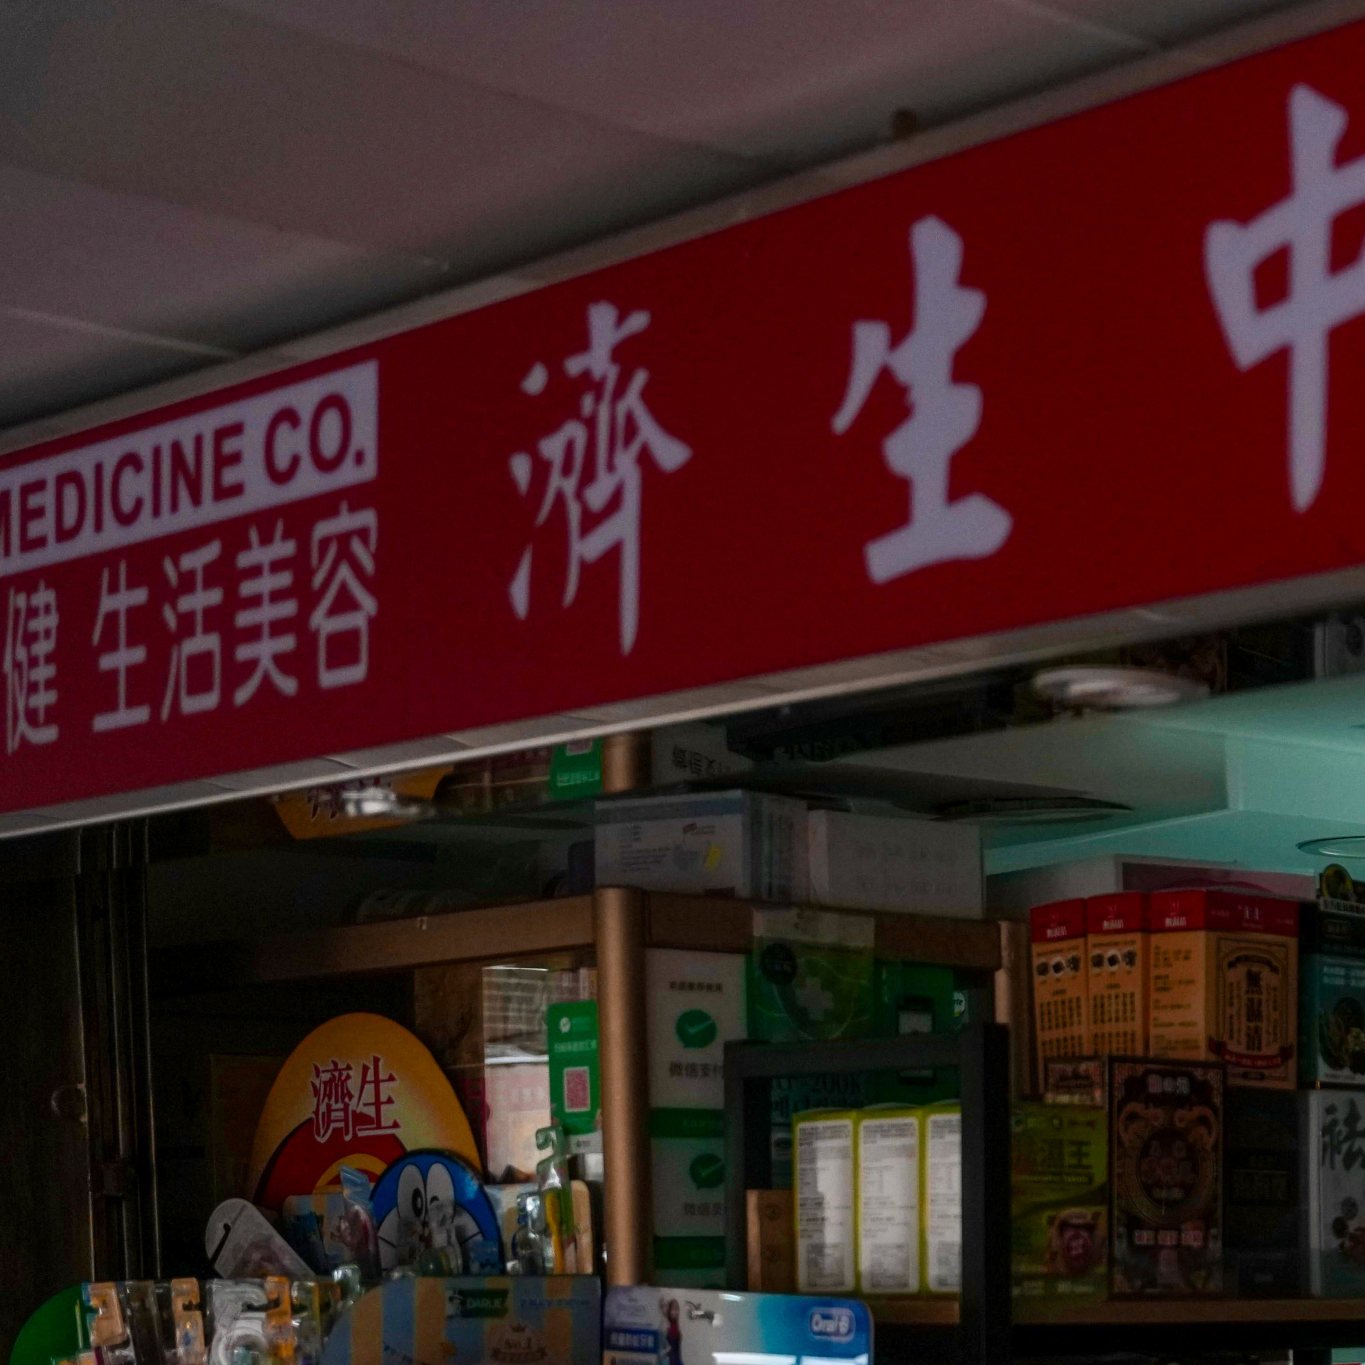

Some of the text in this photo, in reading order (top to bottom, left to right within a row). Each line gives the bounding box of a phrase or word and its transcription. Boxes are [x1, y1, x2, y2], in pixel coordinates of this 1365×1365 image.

[264, 393, 365, 482] CO.
[89, 499, 380, 733] 生活美容
[309, 1055, 402, 1145] 濟生
